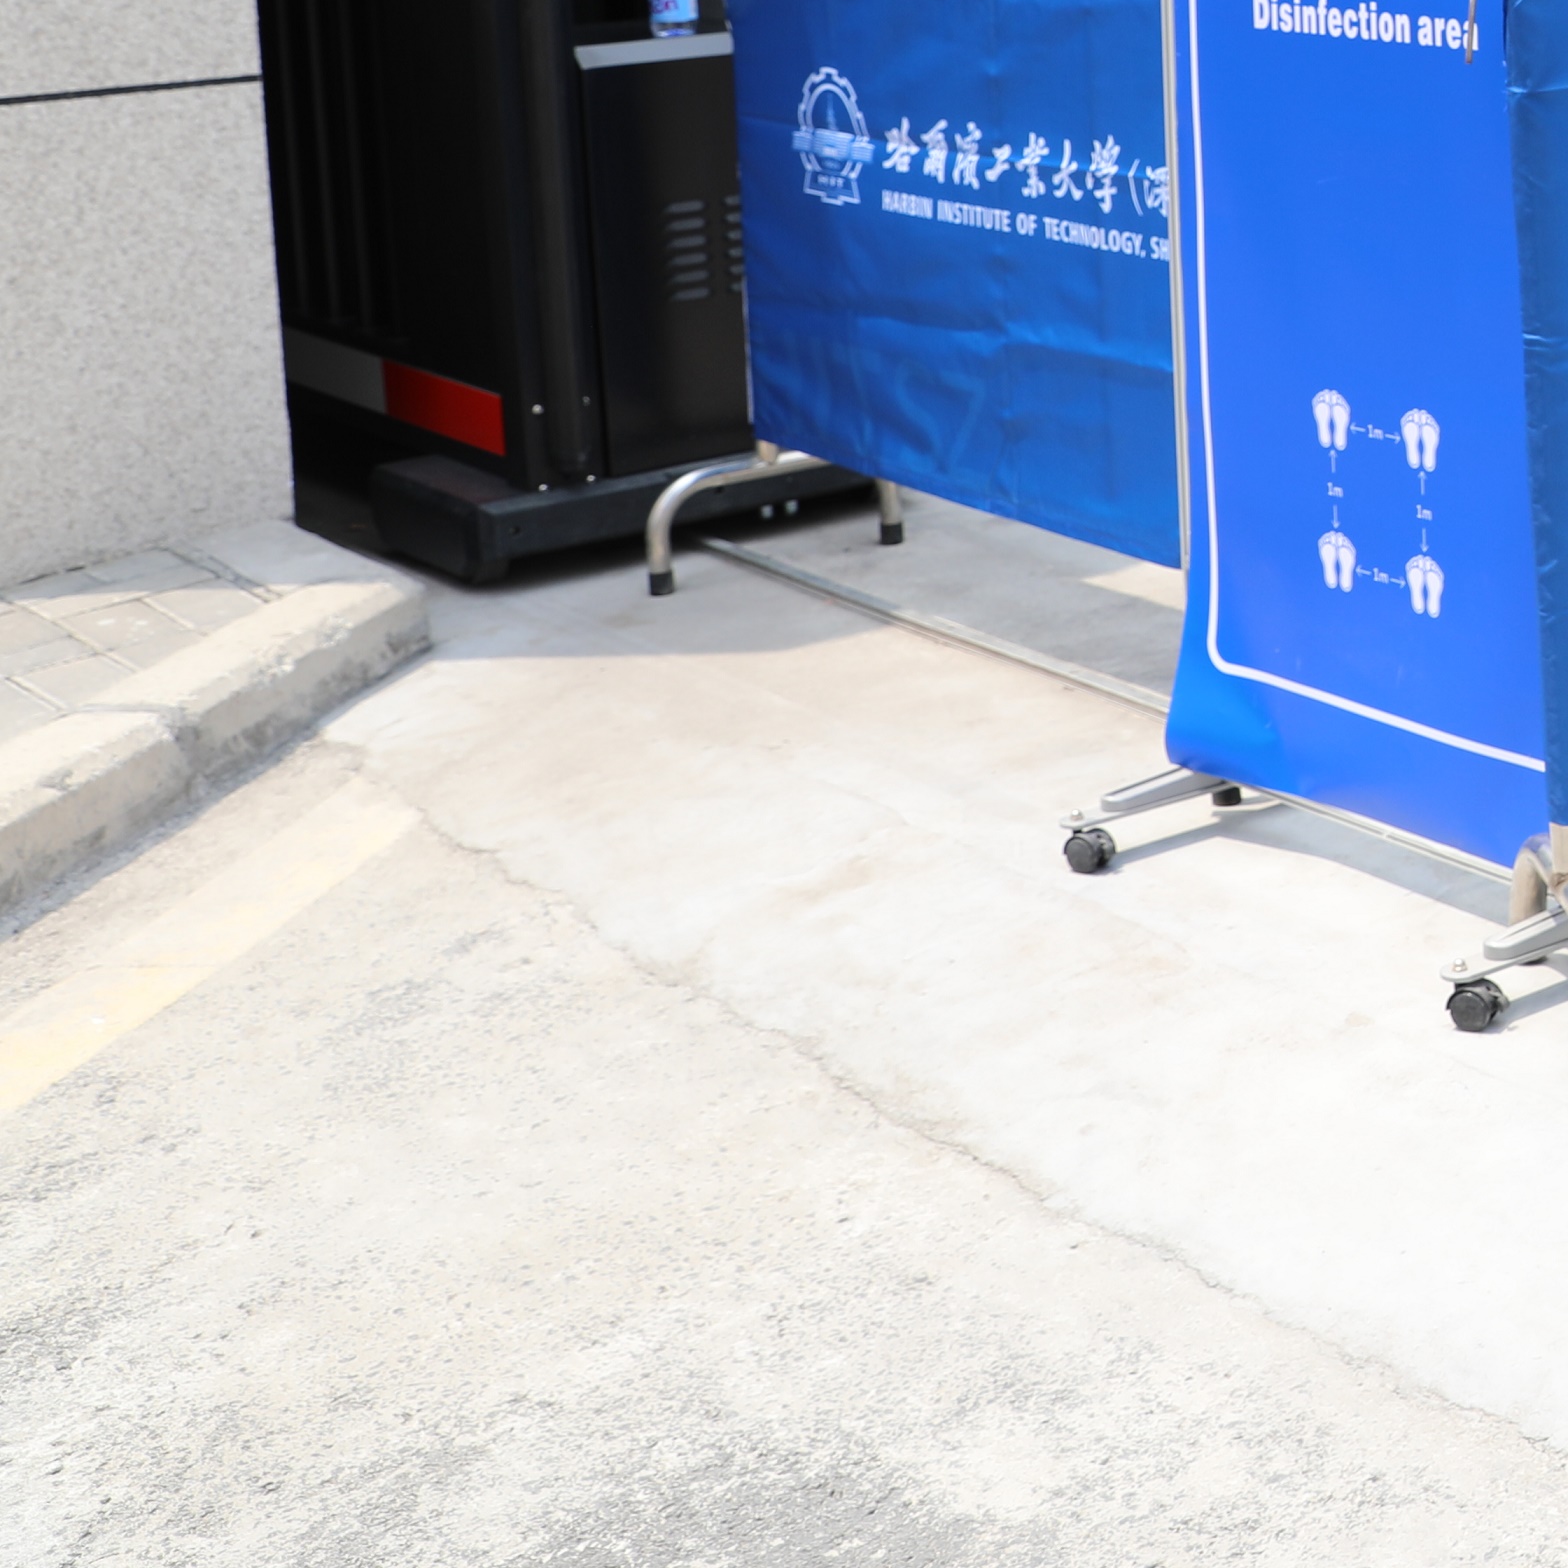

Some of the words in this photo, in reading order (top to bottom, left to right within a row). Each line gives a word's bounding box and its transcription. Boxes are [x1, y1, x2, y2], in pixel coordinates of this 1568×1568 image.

[1417, 14, 1479, 51] area
[881, 189, 933, 220] HARBIN
[937, 199, 1011, 233] INSTITUTE
[1015, 212, 1038, 236] OF
[1042, 216, 1146, 258] TECHNOLOGY,
[1367, 424, 1384, 440] 1m
[1327, 482, 1343, 498] 1m
[1416, 504, 1433, 521] 1m
[1373, 568, 1389, 584] 1m
